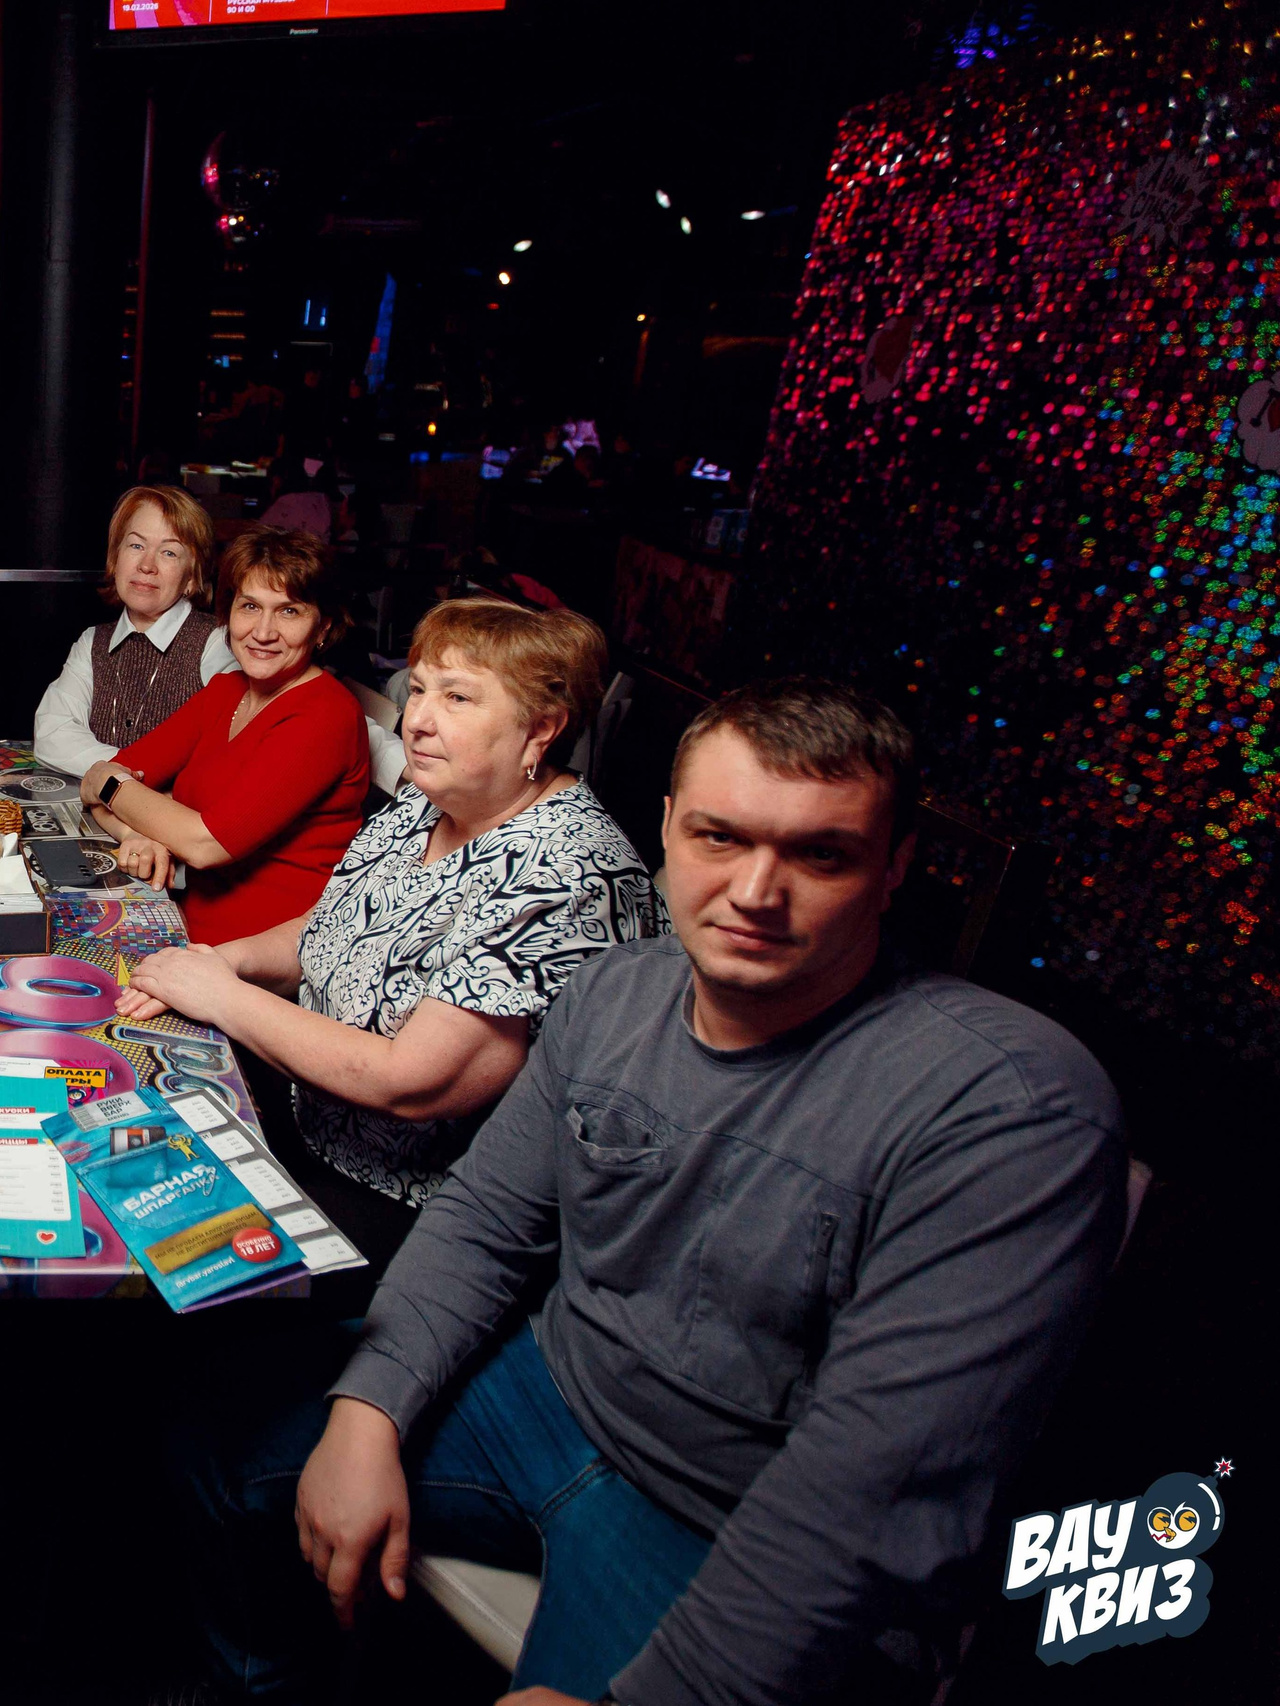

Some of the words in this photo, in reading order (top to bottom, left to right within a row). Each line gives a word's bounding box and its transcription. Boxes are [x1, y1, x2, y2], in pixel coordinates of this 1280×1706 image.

[47, 1069, 102, 1077] ОПЛАТА
[96, 1097, 123, 1108] РУКИ
[103, 1107, 123, 1118] БАР
[122, 1163, 208, 1213] БАРНАЯ
[133, 1172, 220, 1220] ШПАРГАЛКА
[236, 1235, 273, 1249] ОСОБЕННО
[241, 1246, 255, 1257] 18
[255, 1242, 276, 1254] ЛЕТ
